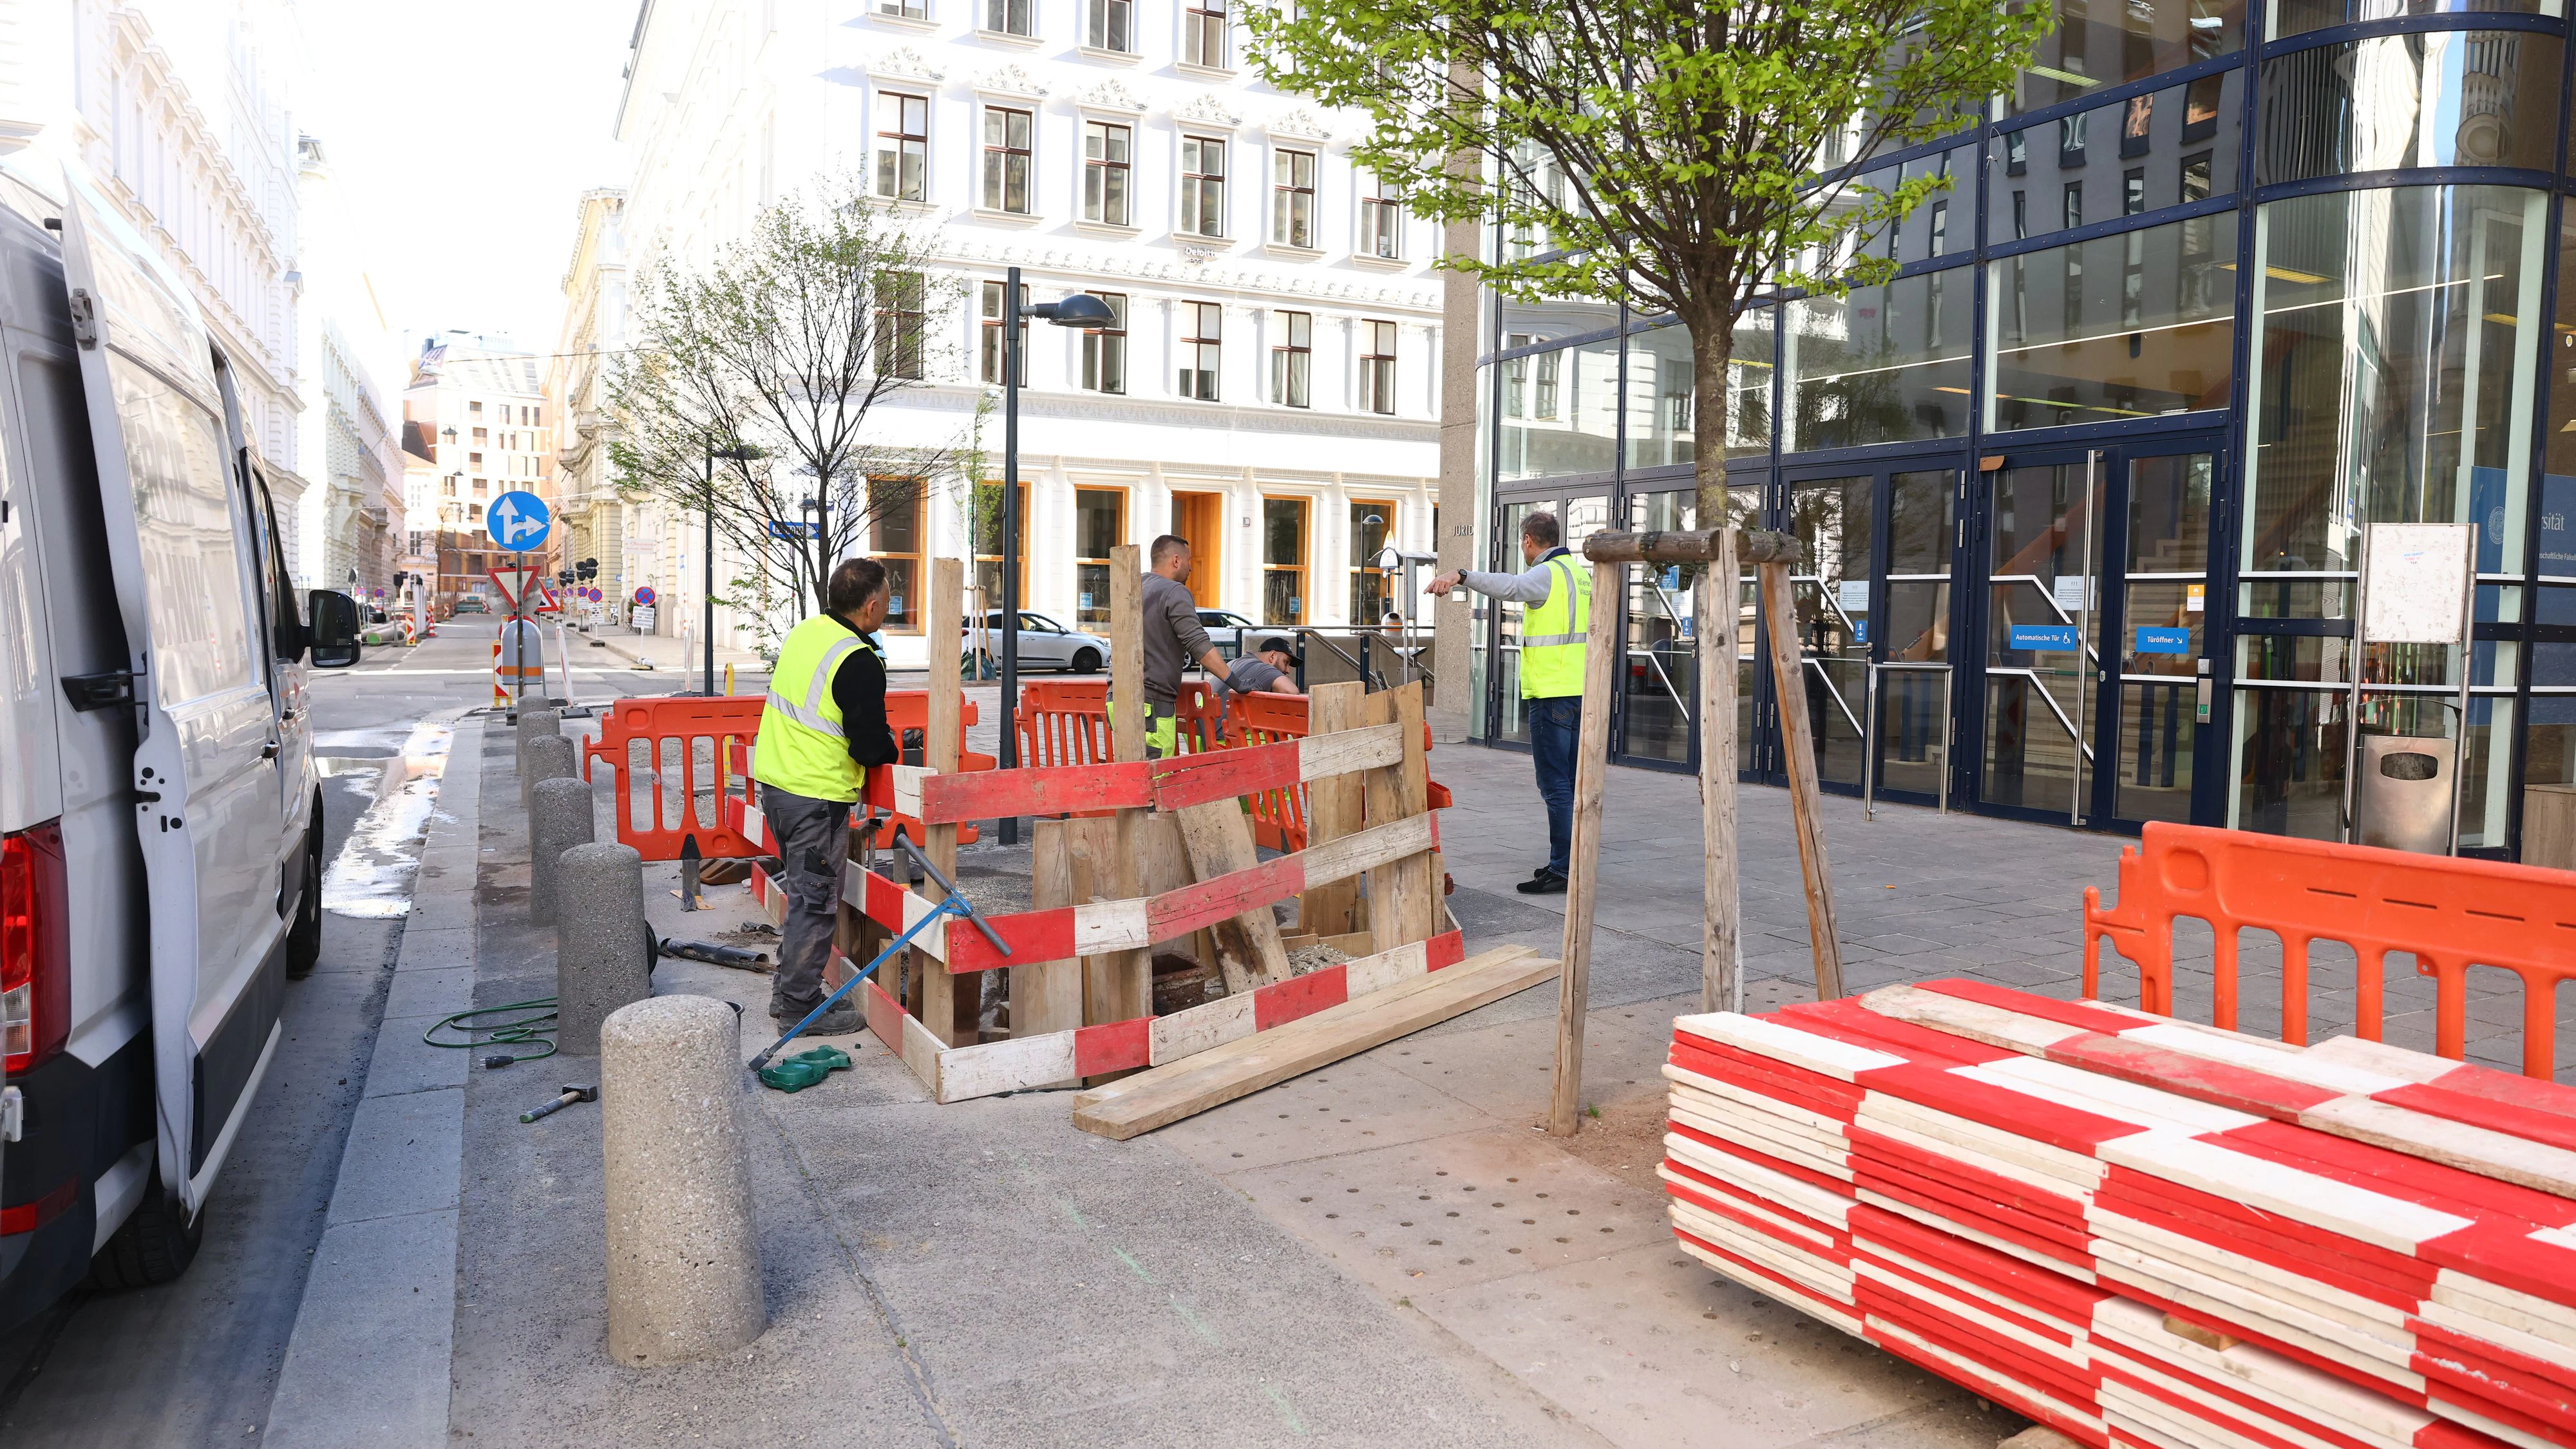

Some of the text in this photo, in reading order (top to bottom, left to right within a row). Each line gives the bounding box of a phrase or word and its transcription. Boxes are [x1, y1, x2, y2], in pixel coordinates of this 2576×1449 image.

[1452, 524, 1473, 536] JURID
[2015, 633, 2060, 642] Automatische Tür
